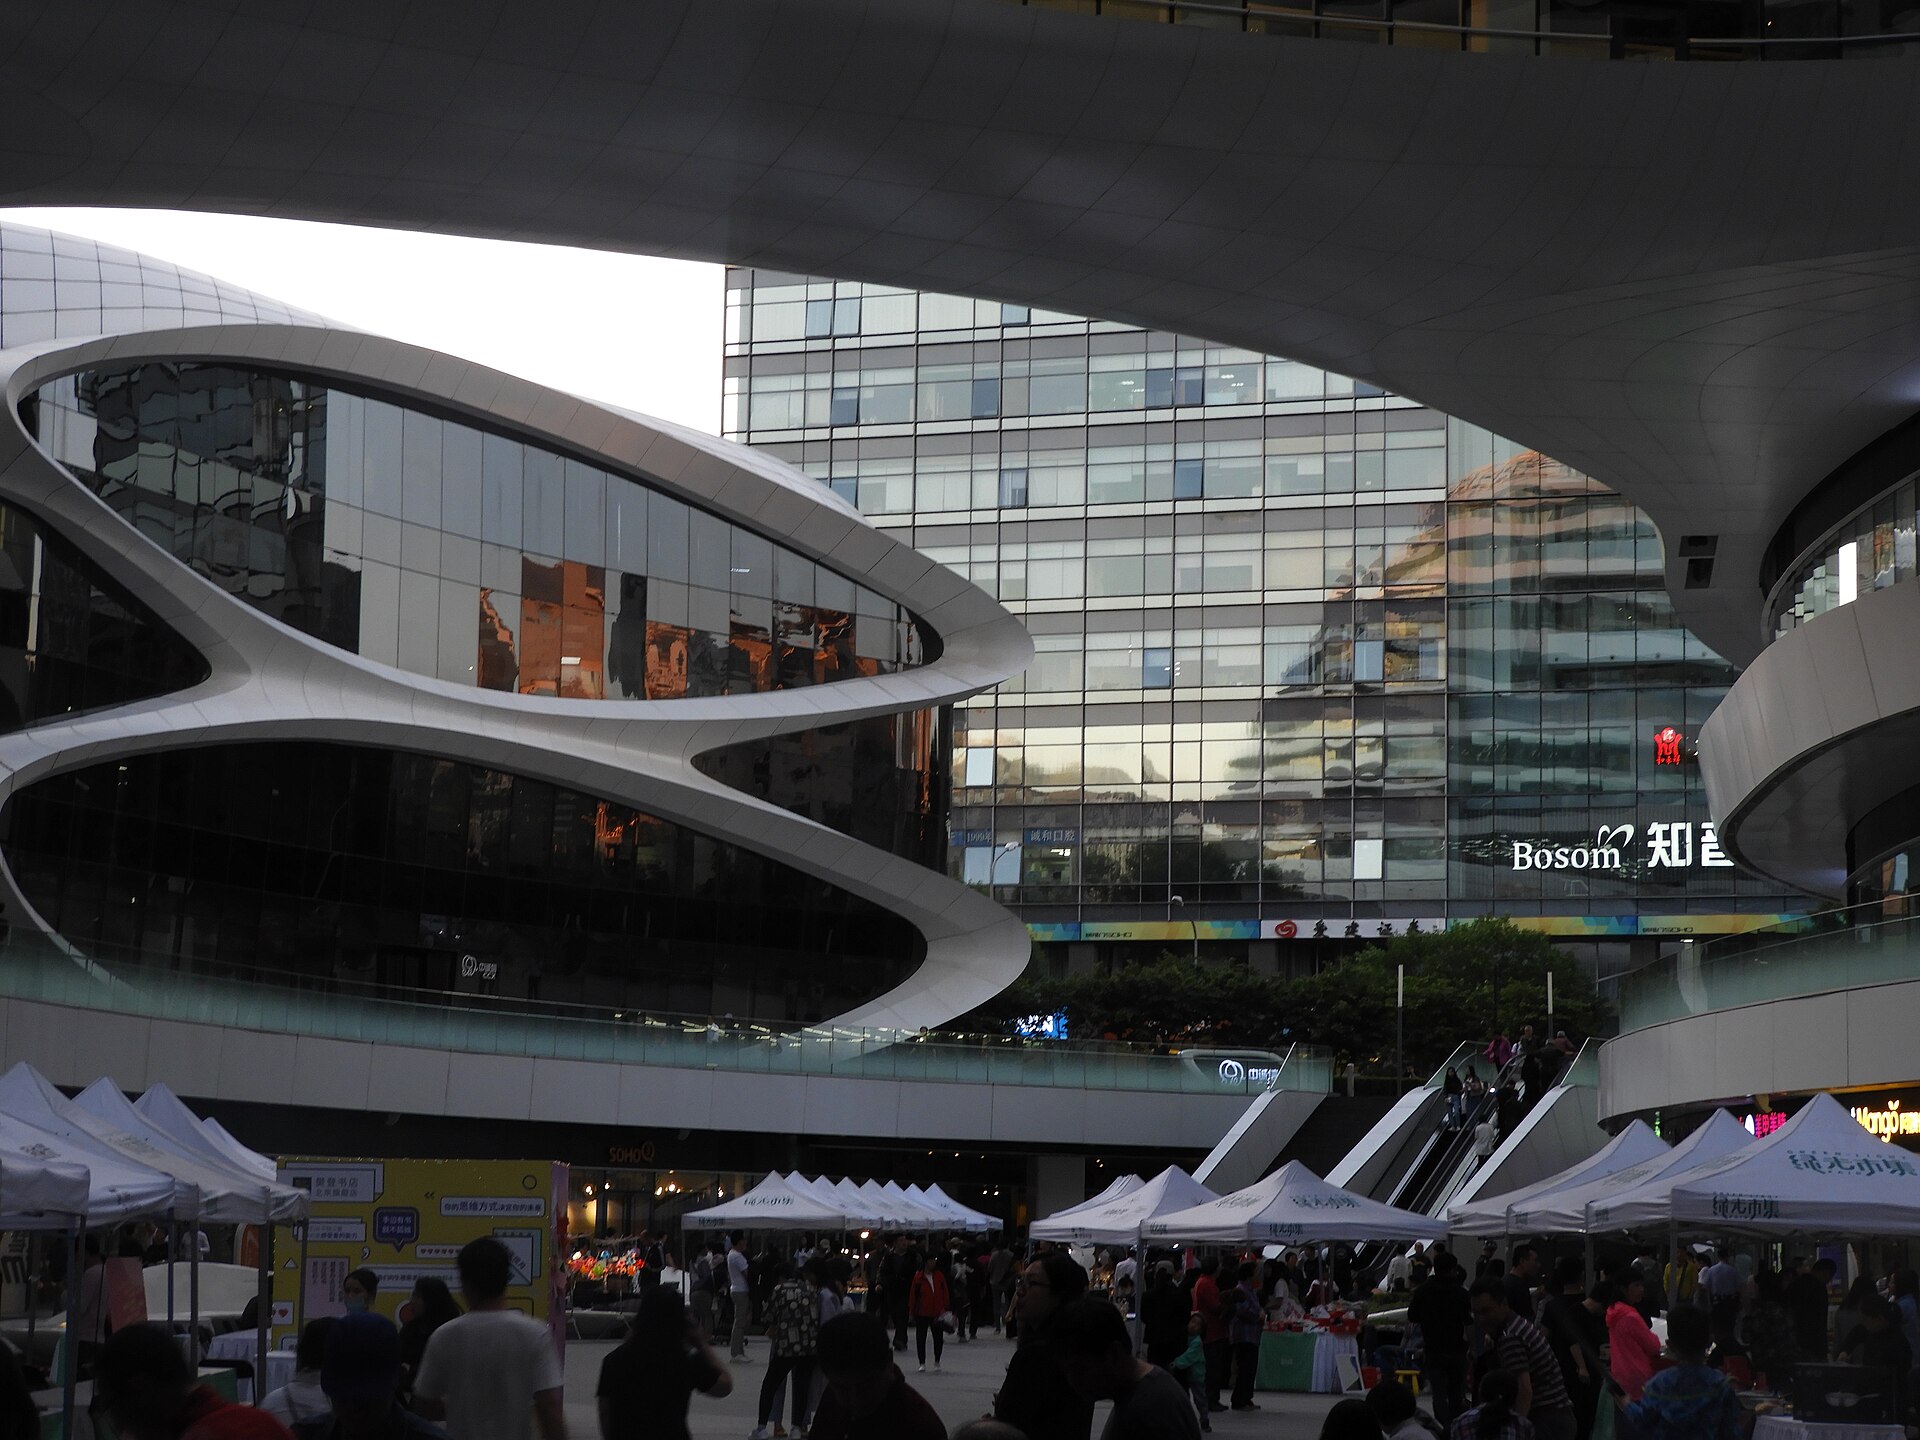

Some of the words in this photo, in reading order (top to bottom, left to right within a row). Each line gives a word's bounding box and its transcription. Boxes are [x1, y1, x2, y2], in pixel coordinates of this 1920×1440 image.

[1030, 829, 1076, 842] 诚和口腔
[1512, 841, 1622, 871] Bosom
